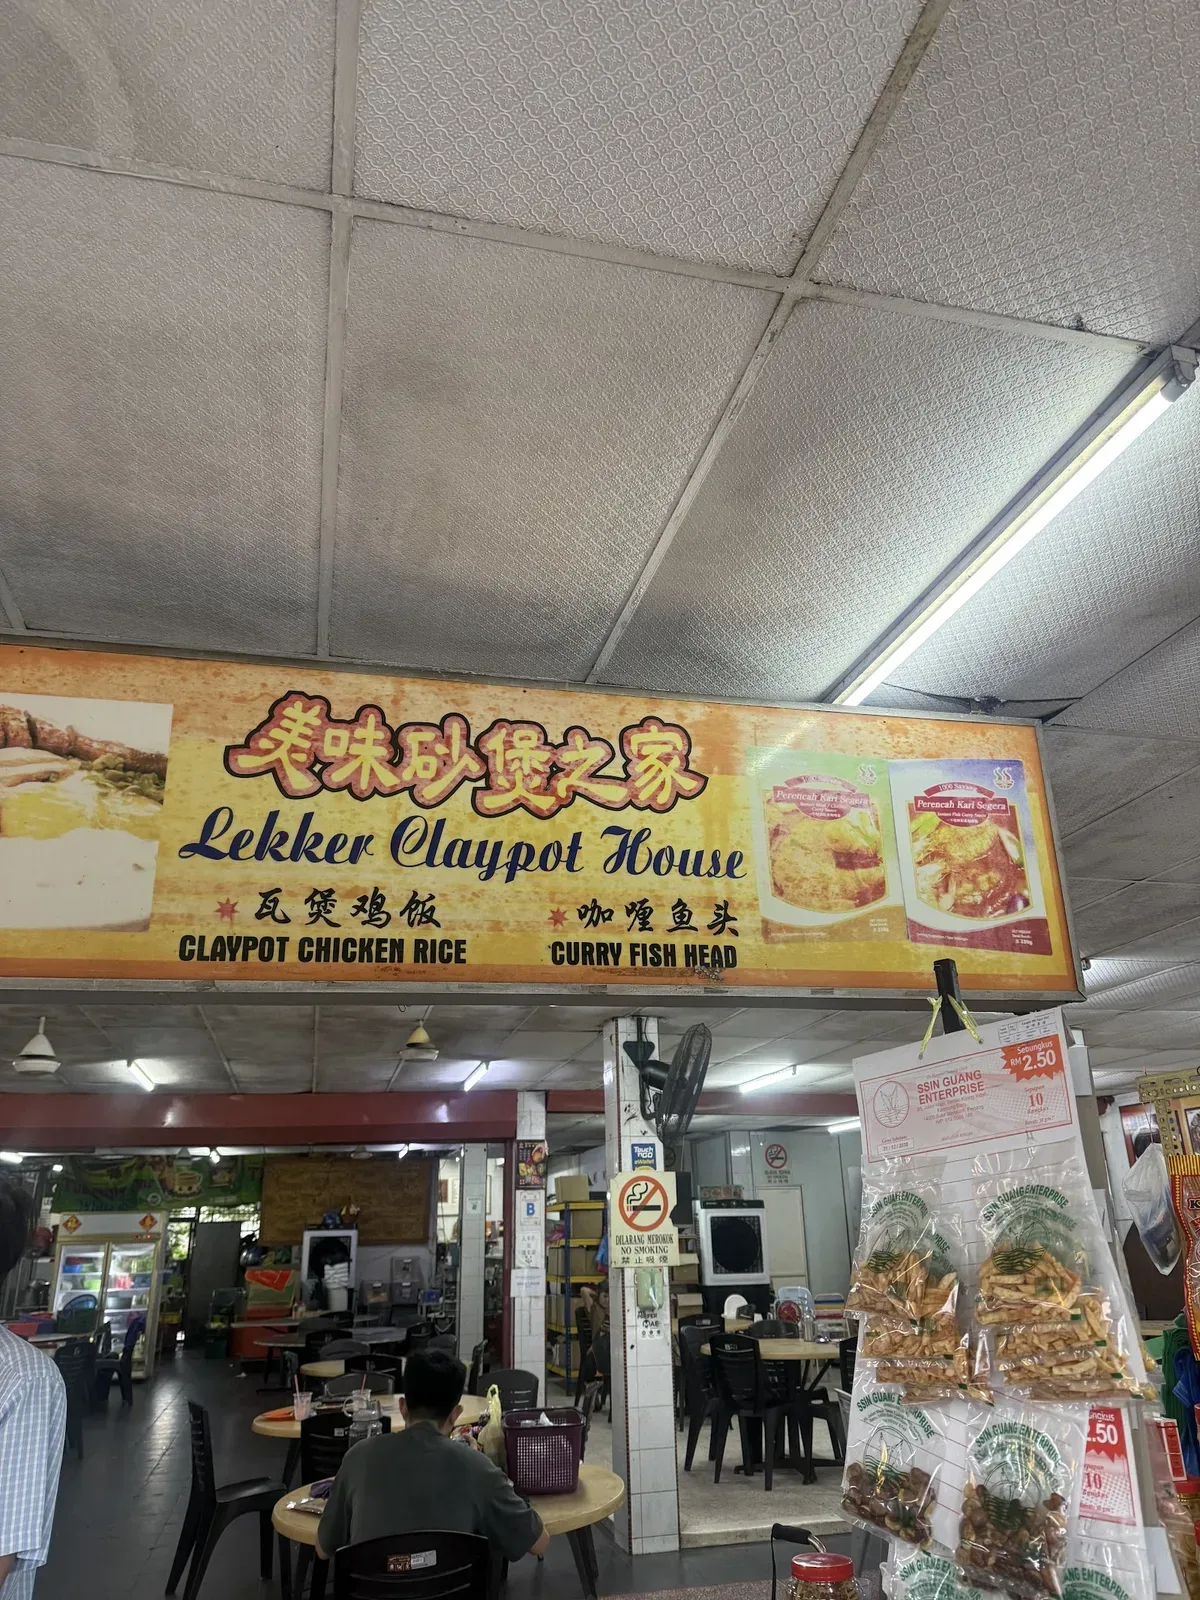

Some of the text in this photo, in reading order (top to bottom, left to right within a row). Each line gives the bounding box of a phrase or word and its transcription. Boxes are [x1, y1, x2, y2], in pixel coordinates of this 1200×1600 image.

[229, 695, 704, 815] 美味砂煲之家
[776, 790, 817, 801] Perencah
[820, 793, 838, 802] Kari
[917, 799, 1006, 811] Perencah Kari Segera
[178, 806, 747, 883] Lekker Claypot House
[254, 886, 442, 929] 瓦煲鸡饭
[576, 897, 739, 937] 咖喱鱼头
[178, 934, 467, 964] CLAYPOT CHICKEN RICE
[550, 941, 738, 969] CURRY FISH HEAD
[1010, 1049, 1056, 1072] RM 2.50
[917, 1079, 940, 1094] SSIN
[942, 1070, 982, 1087] GUANG
[919, 1081, 985, 1105] ENTERPRISE
[1029, 1093, 1044, 1107] 10
[633, 1146, 654, 1154] Touch
[526, 1202, 535, 1216] B
[983, 1202, 1000, 1221] SSIN
[997, 1186, 1025, 1204] GUANG
[1024, 1184, 1069, 1209] ENTERPRISE
[615, 1233, 674, 1246] DILARANG MEROKOK
[621, 1245, 669, 1255] NO SMOKING
[856, 1395, 873, 1412] SSIN
[975, 1430, 992, 1447] SSIN
[992, 1422, 1018, 1436] GUANG
[1020, 1424, 1061, 1468] ENTERPRISE
[1086, 1472, 1102, 1489] 10
